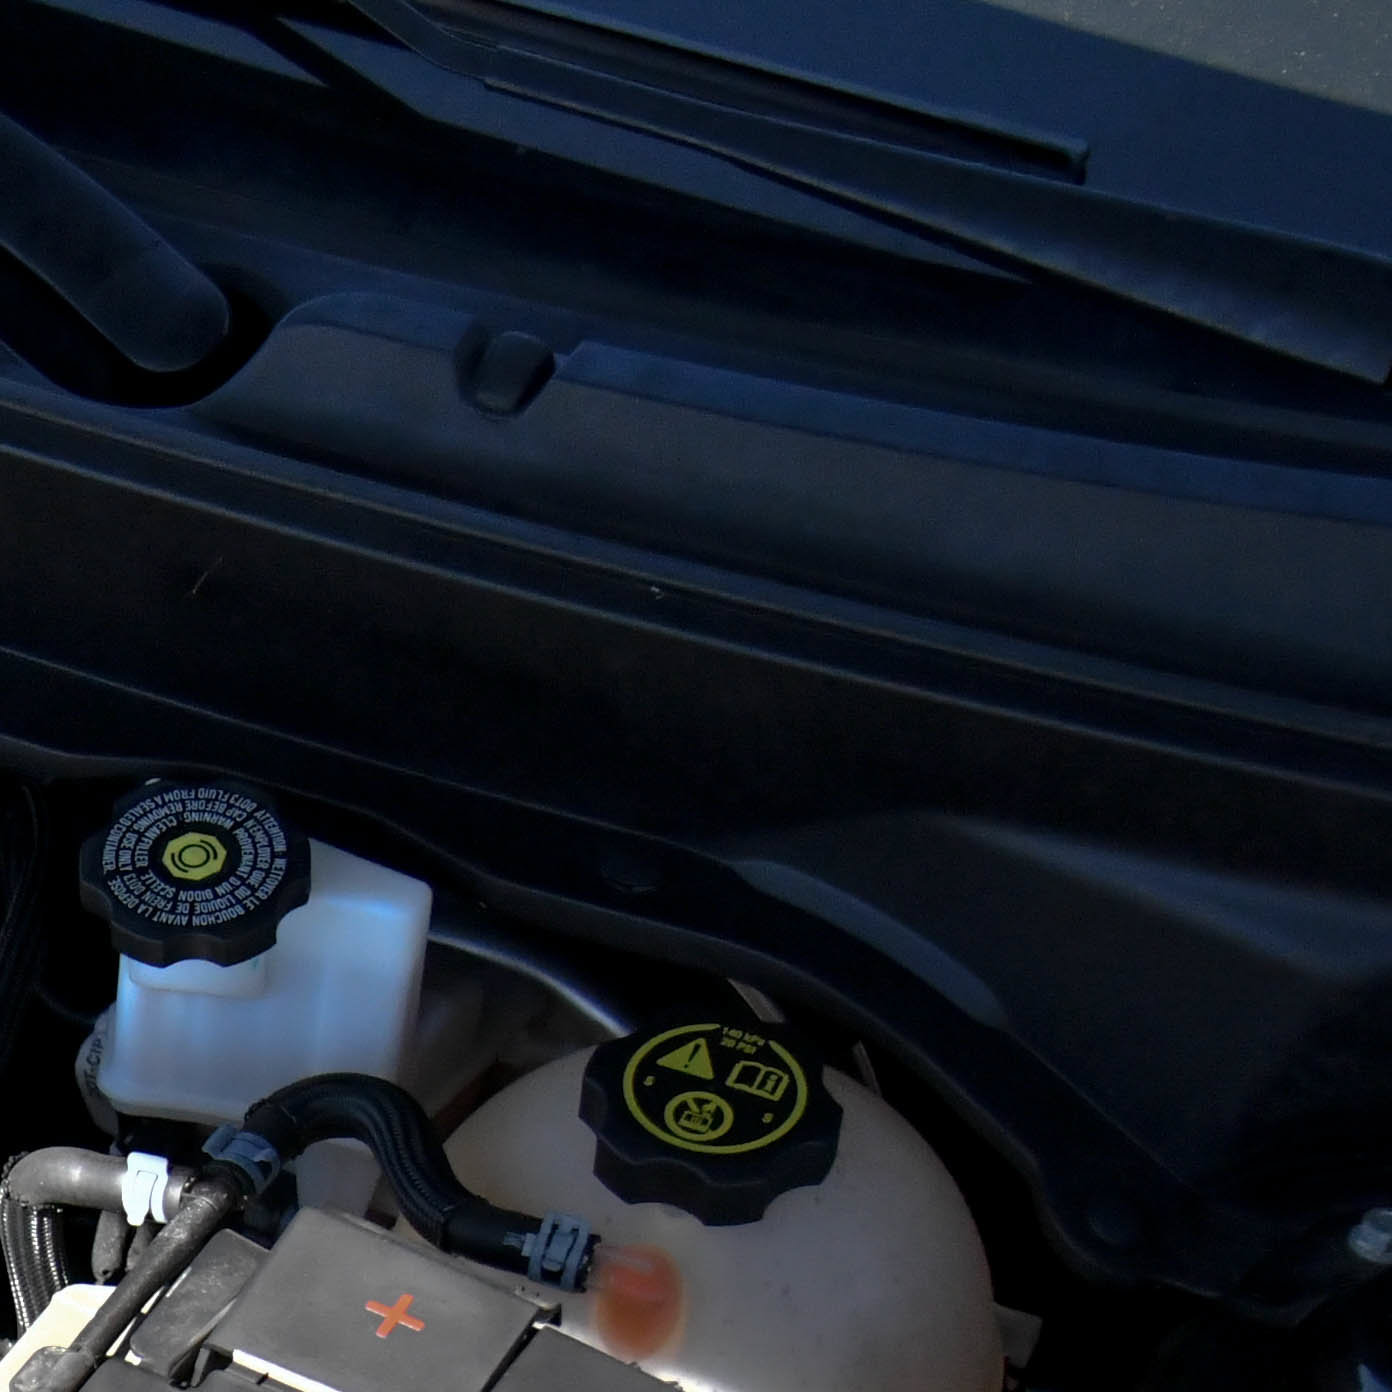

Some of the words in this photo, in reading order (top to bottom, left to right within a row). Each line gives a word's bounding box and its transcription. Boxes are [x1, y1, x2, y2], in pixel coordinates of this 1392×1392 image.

[154, 795, 162, 805] A
[163, 788, 195, 801] FROM
[198, 787, 230, 801] FLUID
[231, 794, 257, 809] DOT3
[120, 797, 156, 825] SEALED
[184, 800, 227, 812] BEFORE
[225, 806, 247, 820] CAP
[144, 815, 177, 839] CLEAN
[121, 832, 139, 849] USE
[135, 835, 153, 867] FILLER
[119, 850, 132, 871] ONLY
[123, 873, 145, 895] DOT3
[246, 869, 266, 887] QUE
[255, 858, 287, 899] NETTOYER
[178, 888, 214, 901] BIDON
[234, 884, 251, 899] DU
[140, 890, 173, 911] FREIN
[175, 901, 189, 914] DE
[194, 893, 237, 913] LIQUIDE
[243, 895, 259, 910] LE
[137, 903, 152, 916] LA
[152, 909, 188, 926] AVANT
[192, 905, 244, 926] BOUCHON
